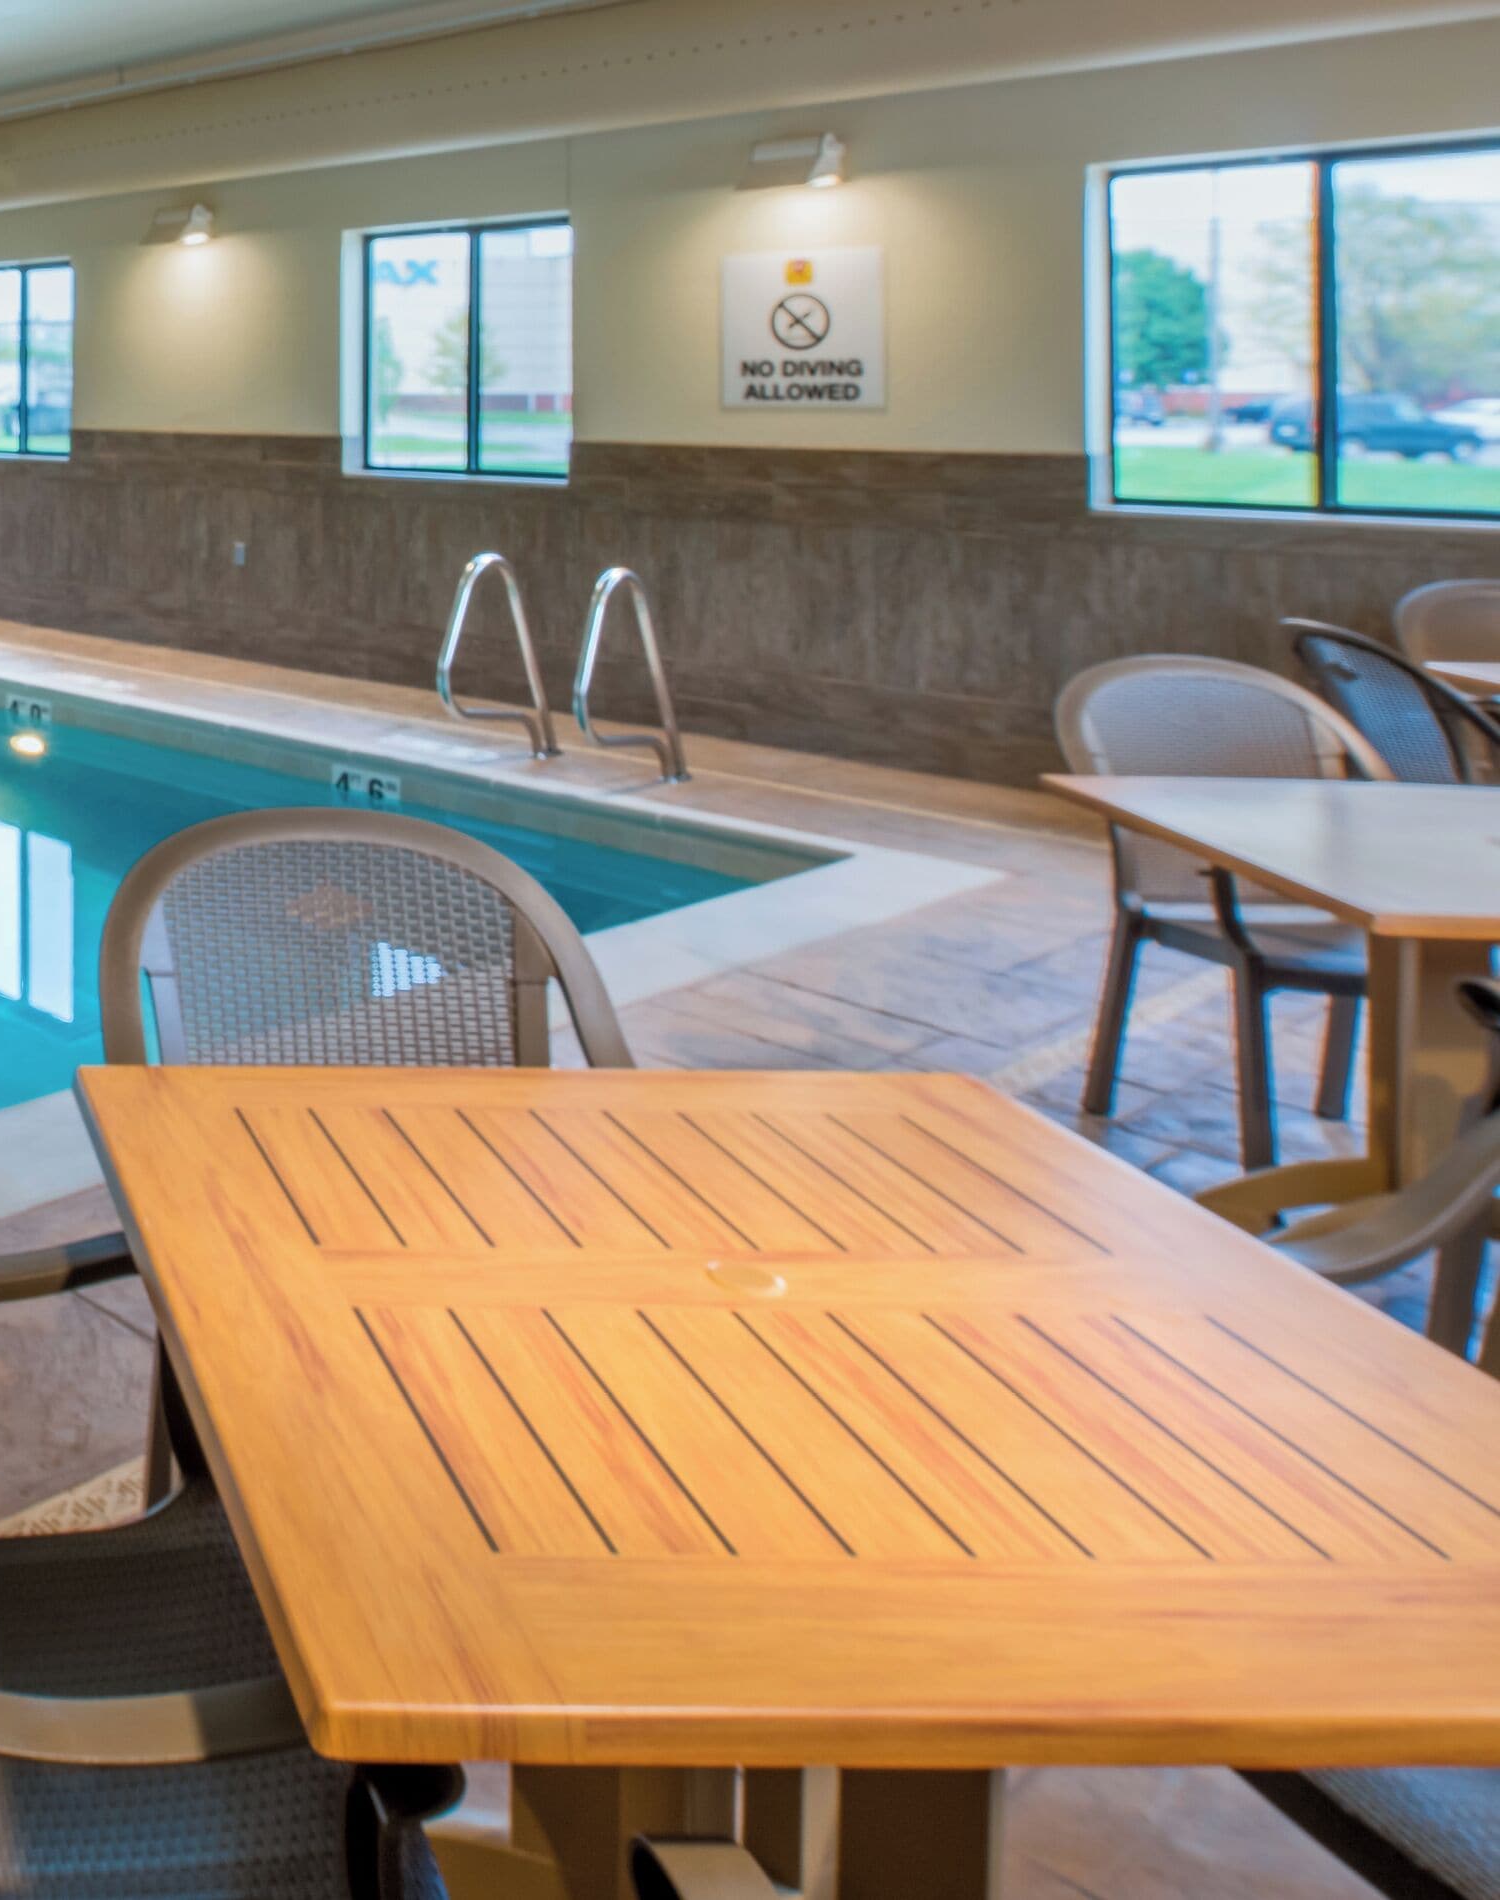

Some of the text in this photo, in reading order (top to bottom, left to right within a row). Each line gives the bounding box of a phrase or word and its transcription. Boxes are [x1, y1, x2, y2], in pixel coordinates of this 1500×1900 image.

[741, 359, 863, 378] NO DIVING
[744, 382, 861, 402] ALLOWED
